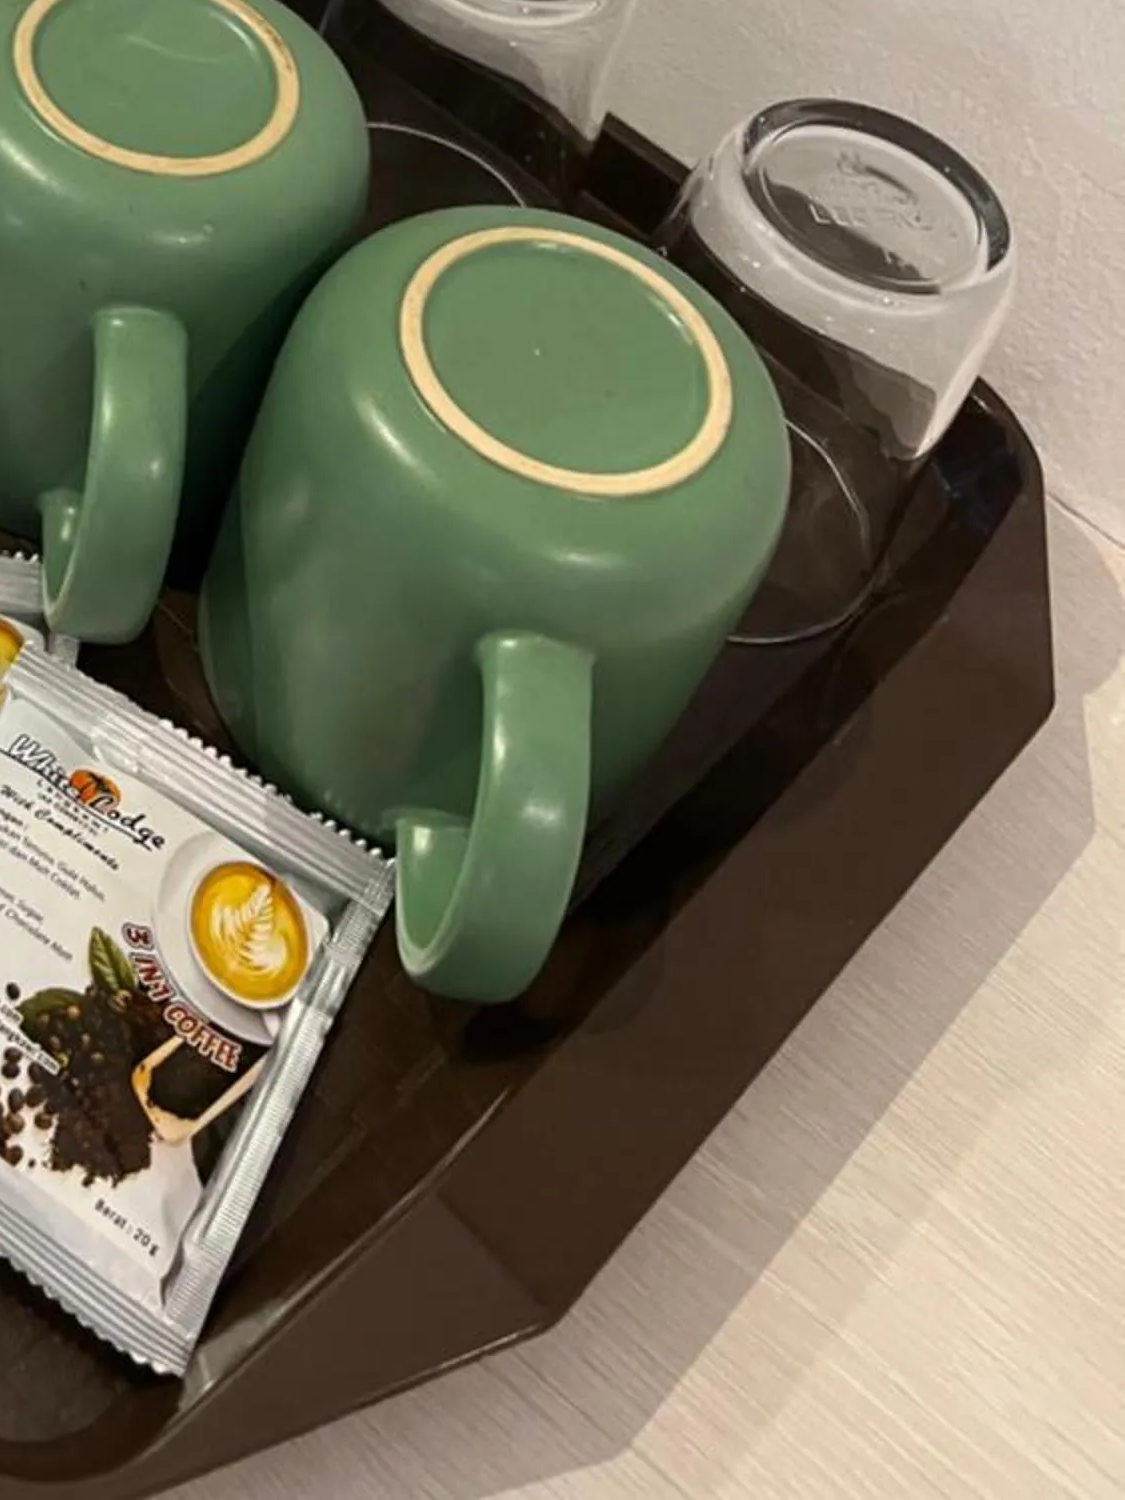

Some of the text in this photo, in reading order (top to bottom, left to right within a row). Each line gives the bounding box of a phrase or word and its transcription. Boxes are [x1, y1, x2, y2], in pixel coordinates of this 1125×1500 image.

[90, 790, 166, 848] Lodge
[124, 924, 154, 949] 3
[132, 1227, 152, 1247] 20
